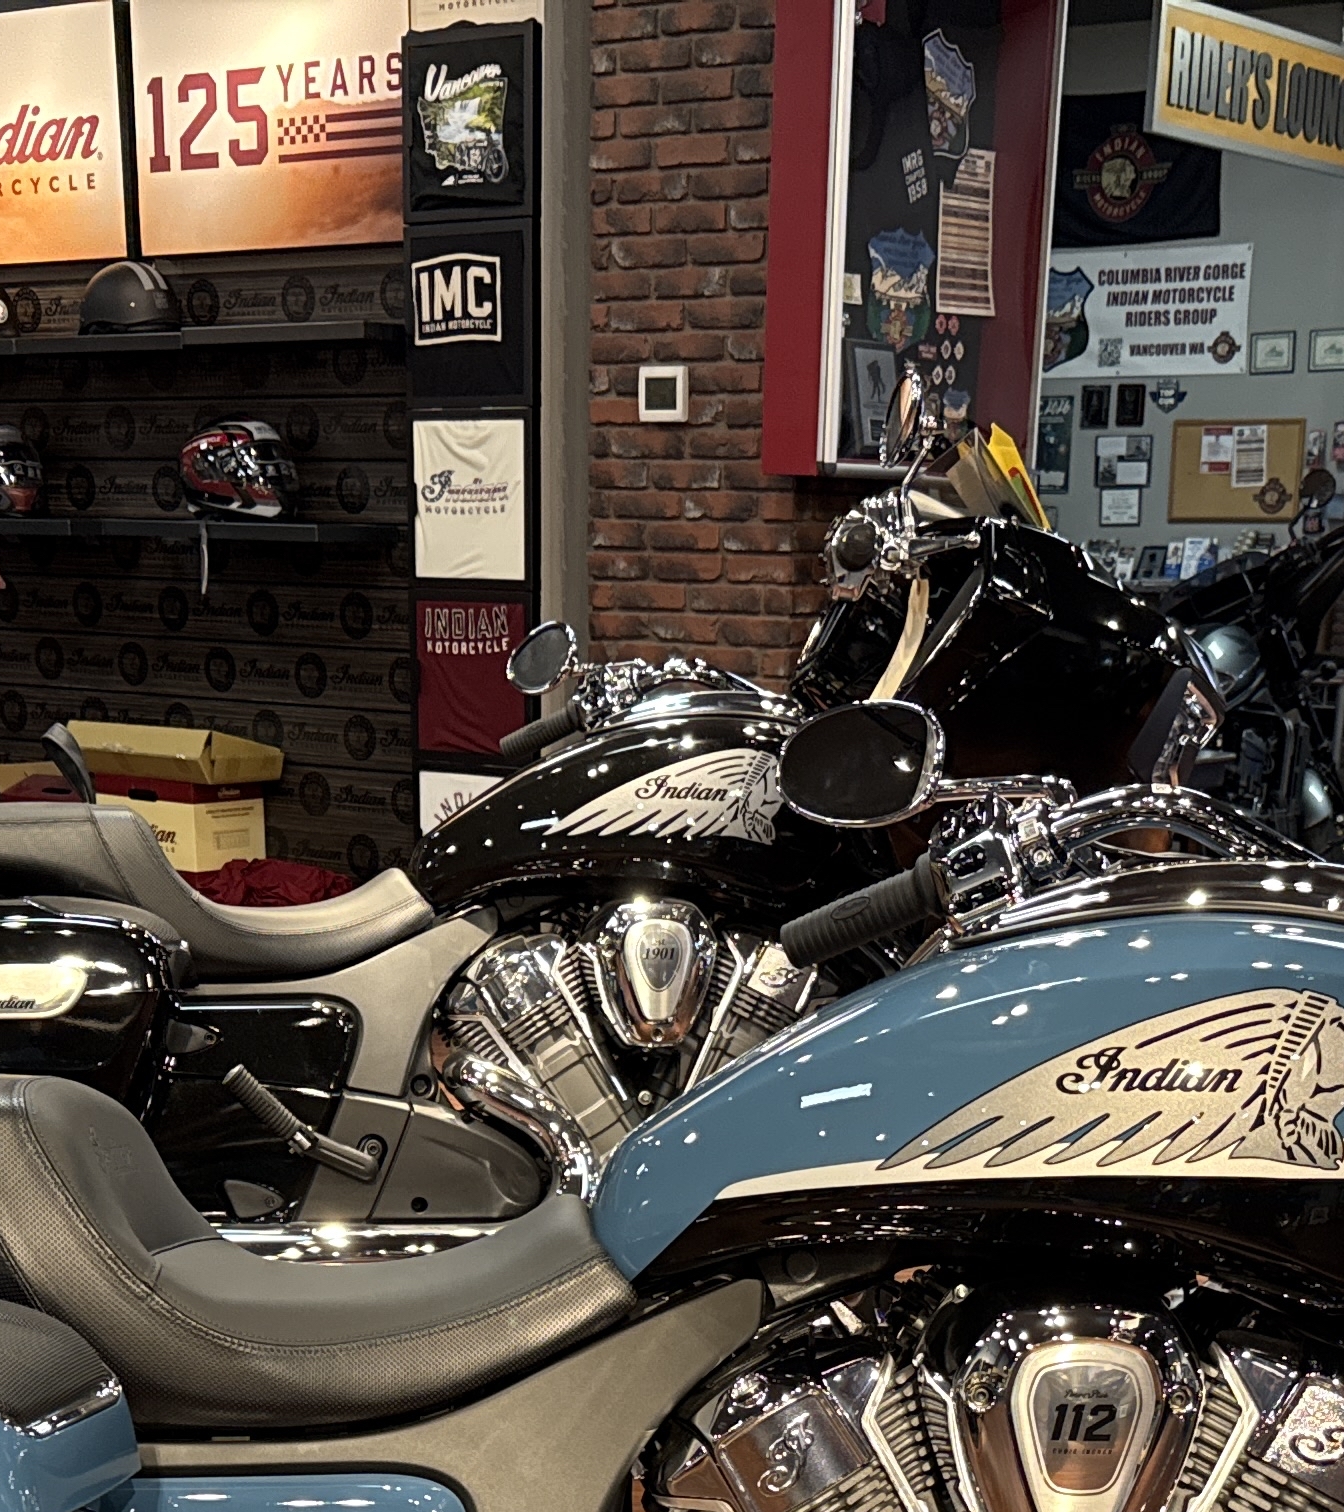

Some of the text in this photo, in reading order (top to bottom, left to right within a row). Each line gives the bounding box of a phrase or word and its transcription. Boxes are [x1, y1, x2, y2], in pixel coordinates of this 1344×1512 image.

[275, 52, 403, 100] YEARS
[424, 63, 503, 102] Vancouver
[1167, 26, 1273, 131] RIDER'S
[146, 66, 269, 174] 125
[1098, 262, 1247, 287] COLUMBIA RIVER GORGE
[419, 265, 493, 323] IMC
[1106, 285, 1236, 307] INDIAN MOTORCYCLE
[1125, 308, 1218, 328] RIDERS GROUP
[1129, 342, 1205, 357] VANCOUVER WA
[424, 504, 506, 515] MOTORCYCLE
[424, 605, 510, 640] INDIAN
[426, 636, 511, 655] MOTORCYCLE
[634, 773, 729, 802] Indian
[642, 946, 676, 962] 1901
[1055, 1046, 1244, 1095] Indian
[1050, 1403, 1118, 1442] 112
